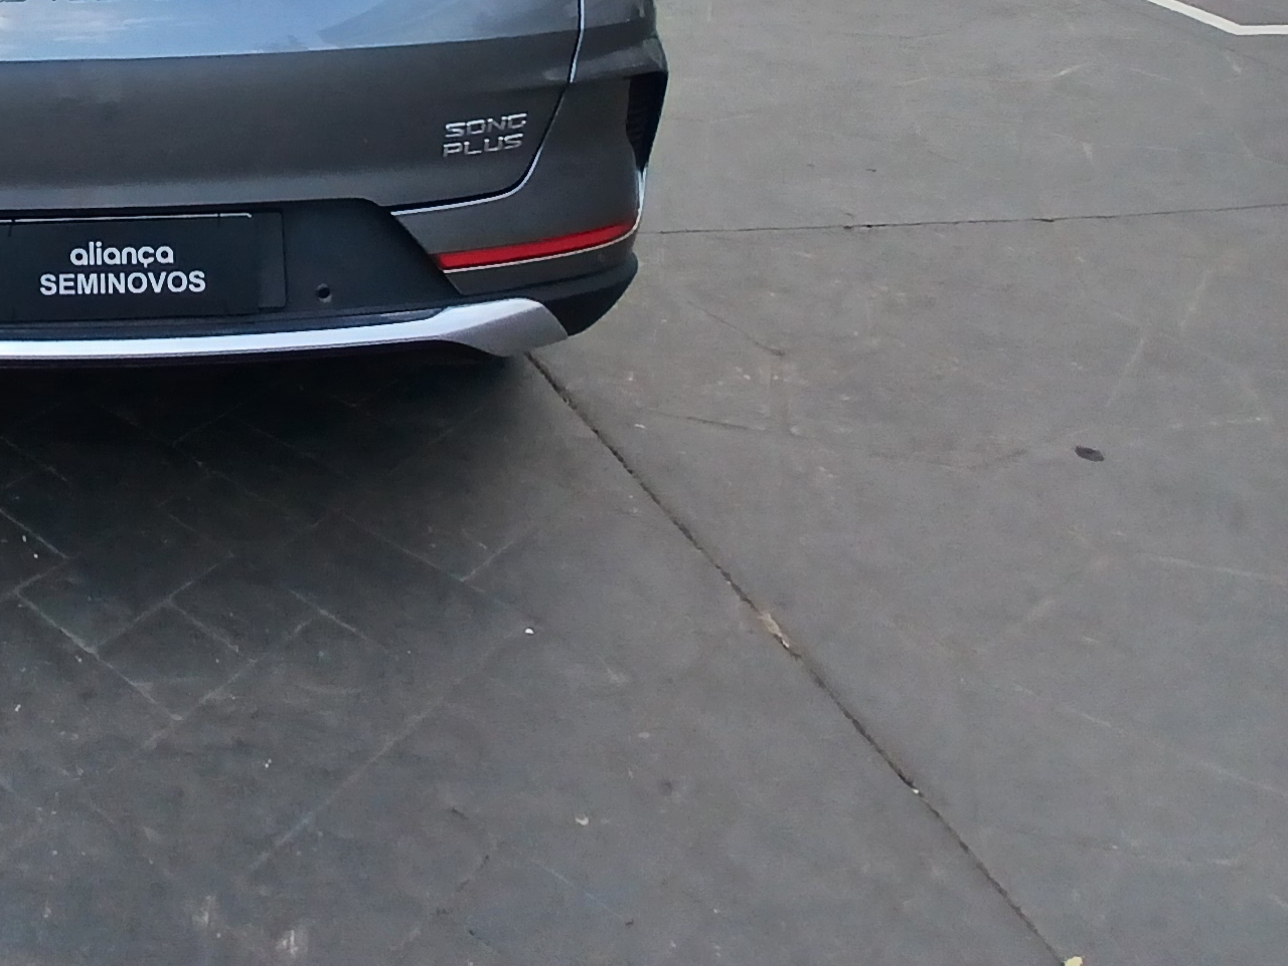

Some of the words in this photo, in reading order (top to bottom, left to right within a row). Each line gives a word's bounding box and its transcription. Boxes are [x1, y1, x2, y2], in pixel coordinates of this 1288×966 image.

[444, 113, 528, 138] SONG
[442, 133, 524, 158] PLUS
[69, 241, 175, 269] aliança
[39, 270, 207, 296] SEMINOVOS
